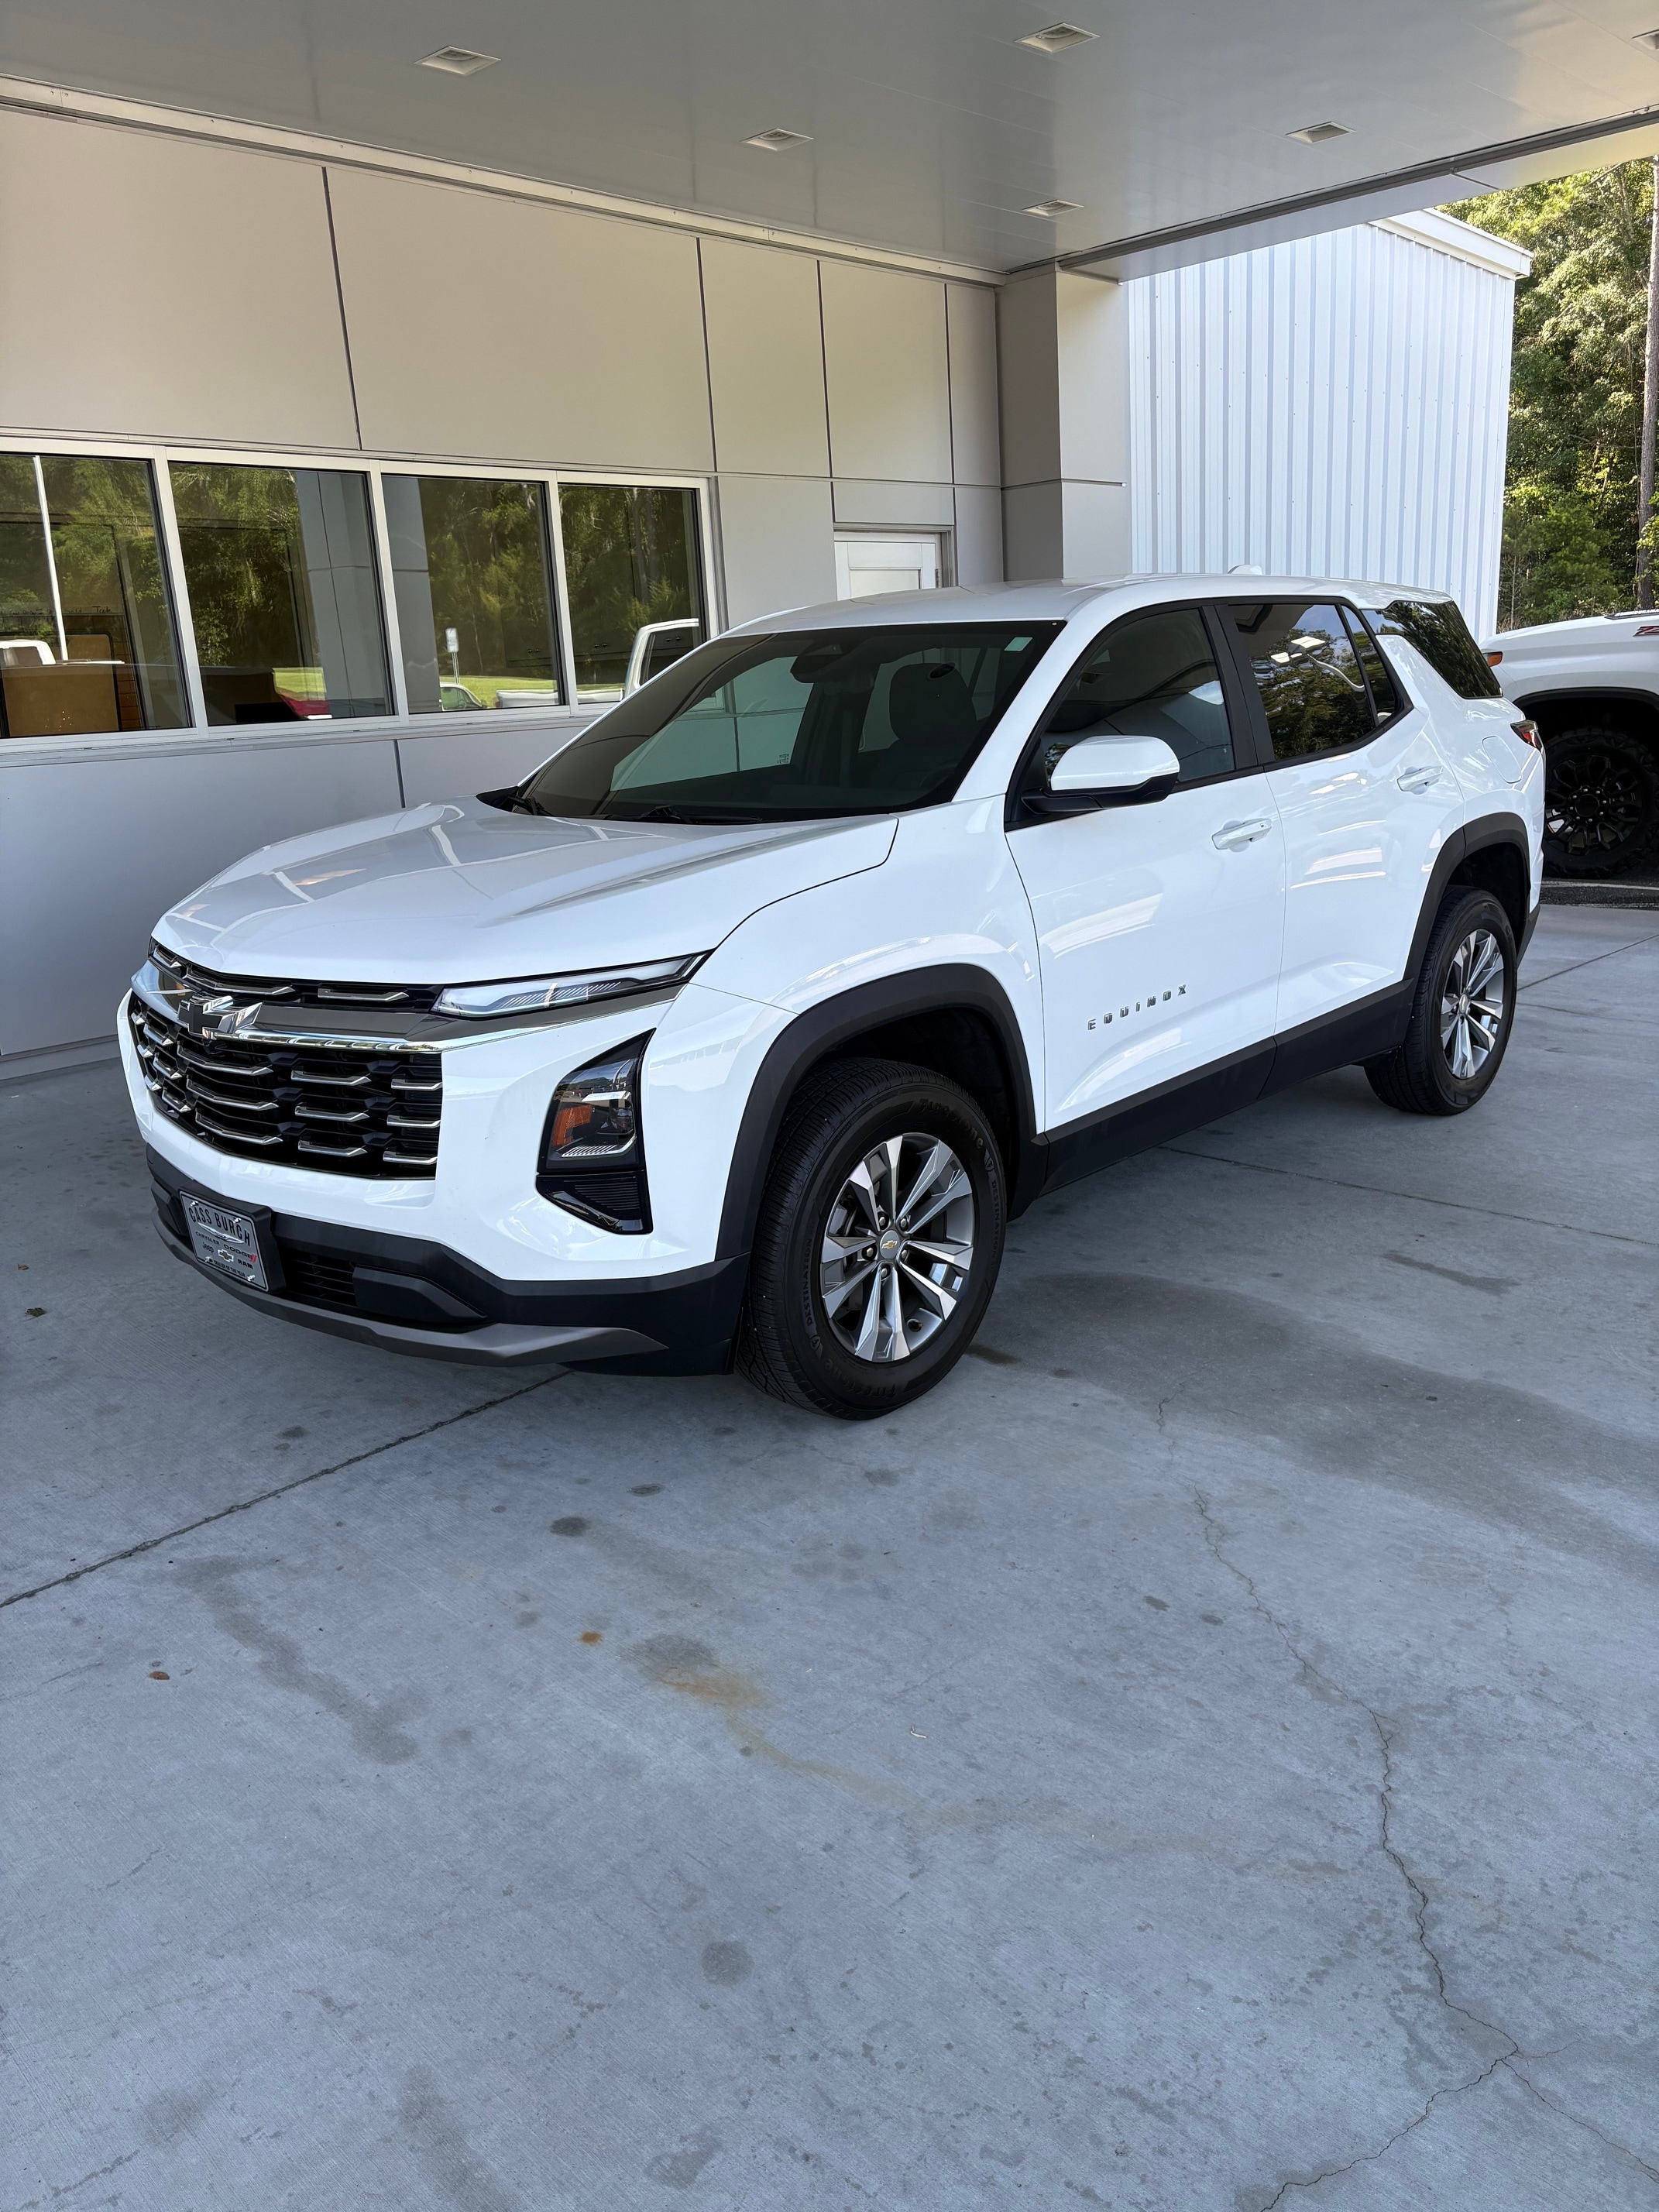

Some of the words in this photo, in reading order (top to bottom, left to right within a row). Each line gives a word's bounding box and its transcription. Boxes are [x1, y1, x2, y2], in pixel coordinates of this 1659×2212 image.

[1087, 984, 1187, 1030] EQUINOX
[188, 1207, 212, 1224] CASS
[215, 1212, 250, 1246] BURCH
[991, 1180, 1001, 1259] DESTINATION
[195, 1231, 220, 1245] CHRYSLER
[224, 1244, 252, 1259] DODGE
[202, 1242, 215, 1254] Jeep
[237, 1259, 253, 1269] RAM
[802, 1238, 813, 1327] DESTINATION
